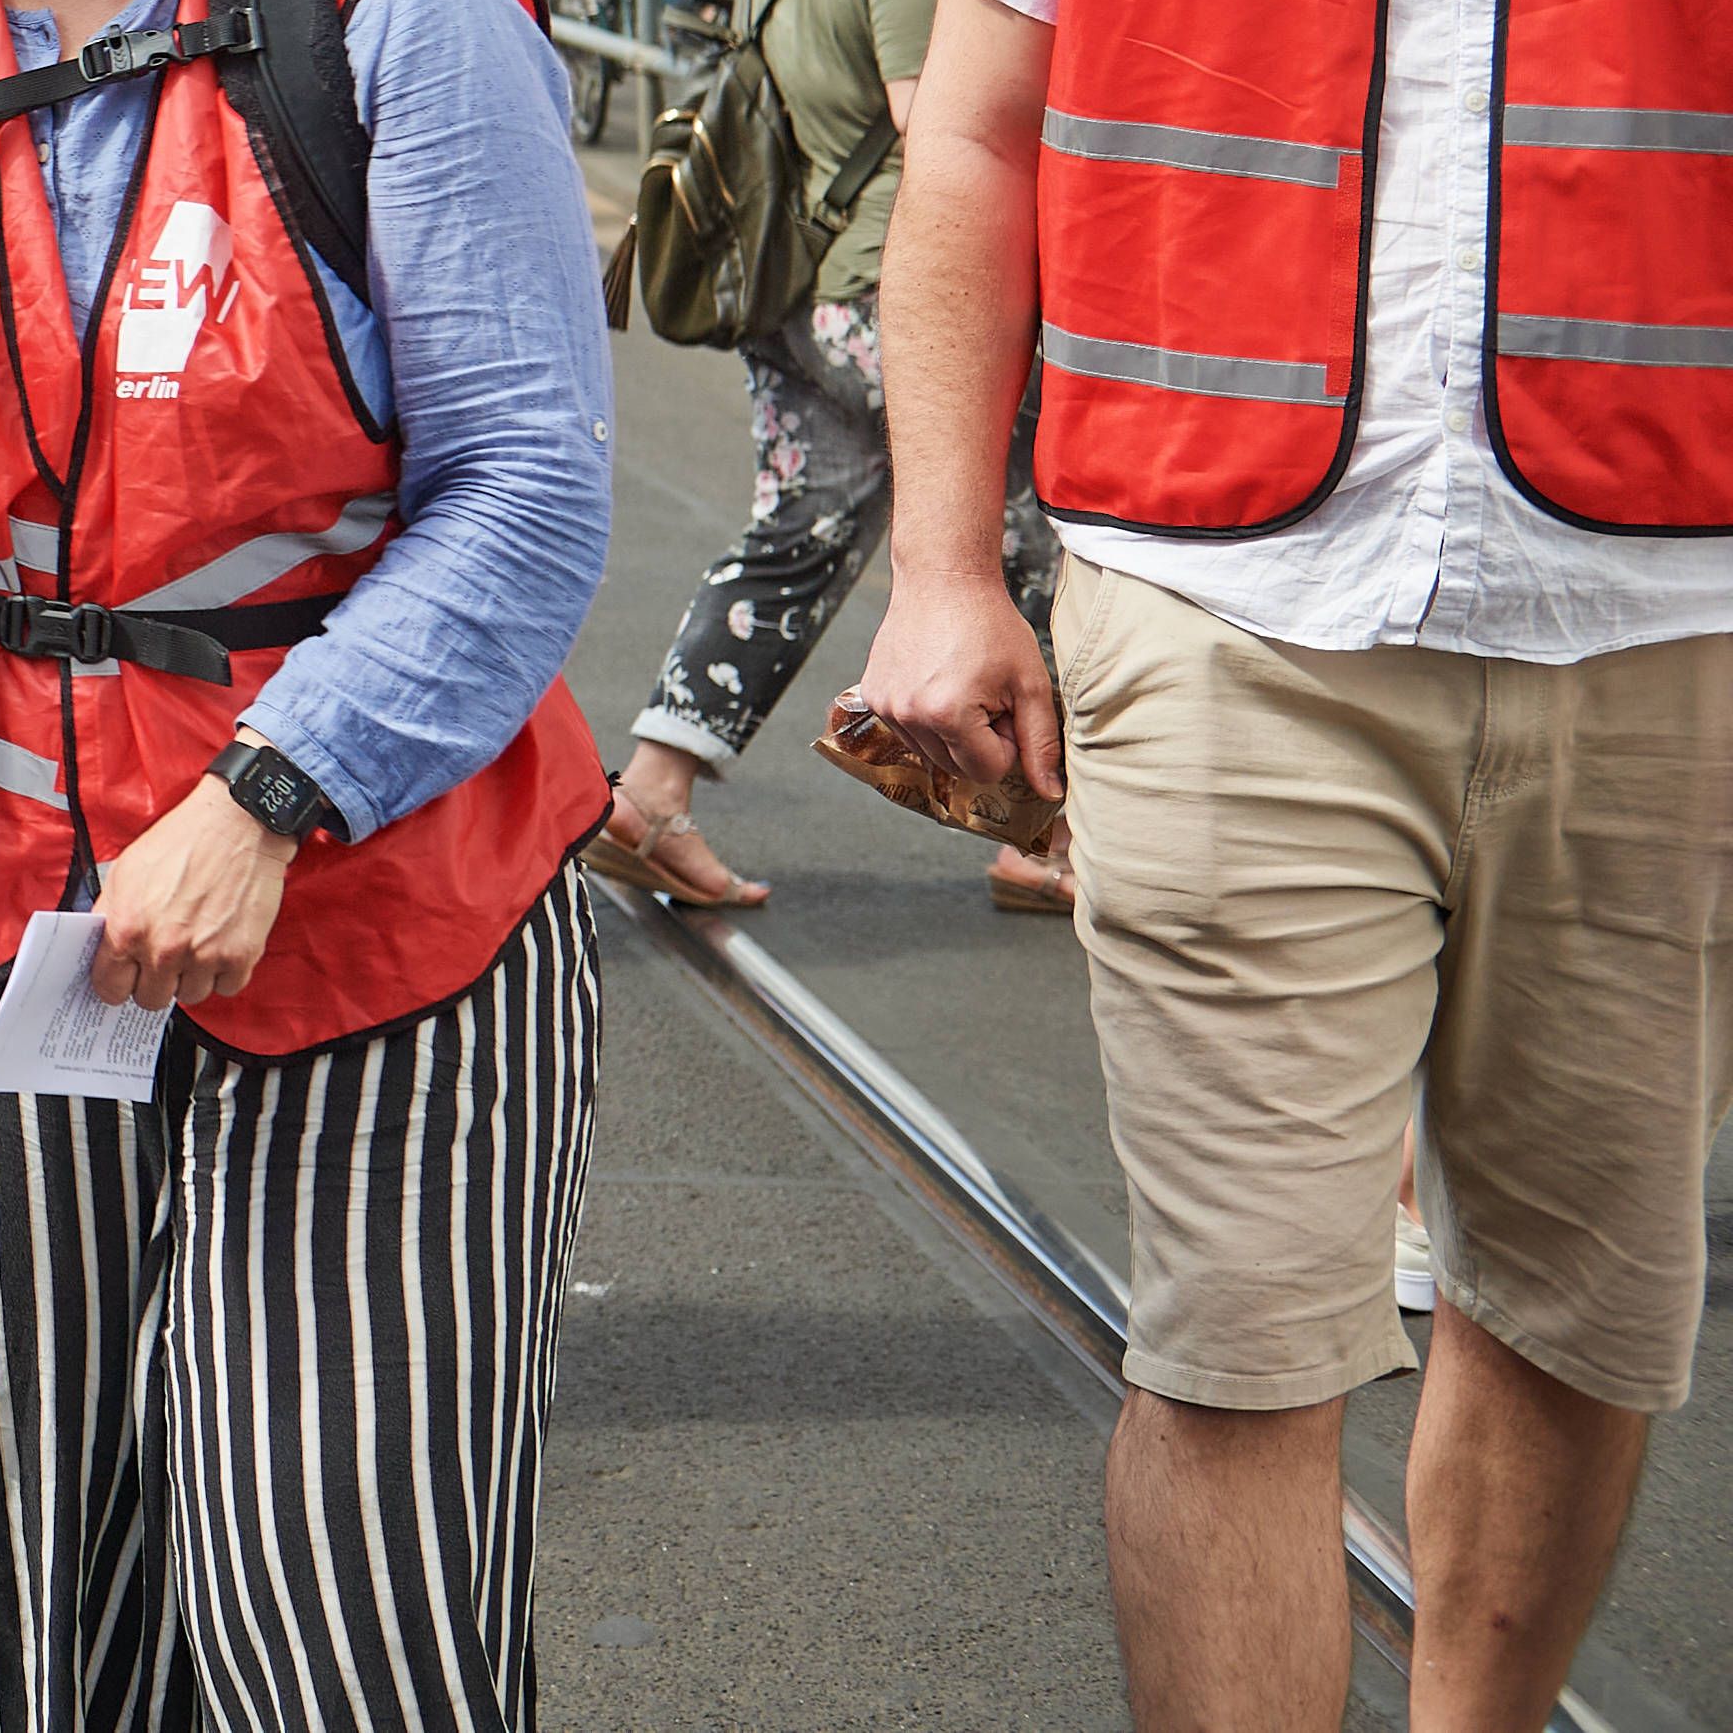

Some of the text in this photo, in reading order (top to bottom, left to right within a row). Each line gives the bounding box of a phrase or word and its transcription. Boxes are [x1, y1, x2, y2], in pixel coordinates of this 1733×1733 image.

[121, 258, 242, 325] EW
[114, 375, 180, 400] erlin
[258, 773, 297, 814] 10:22
